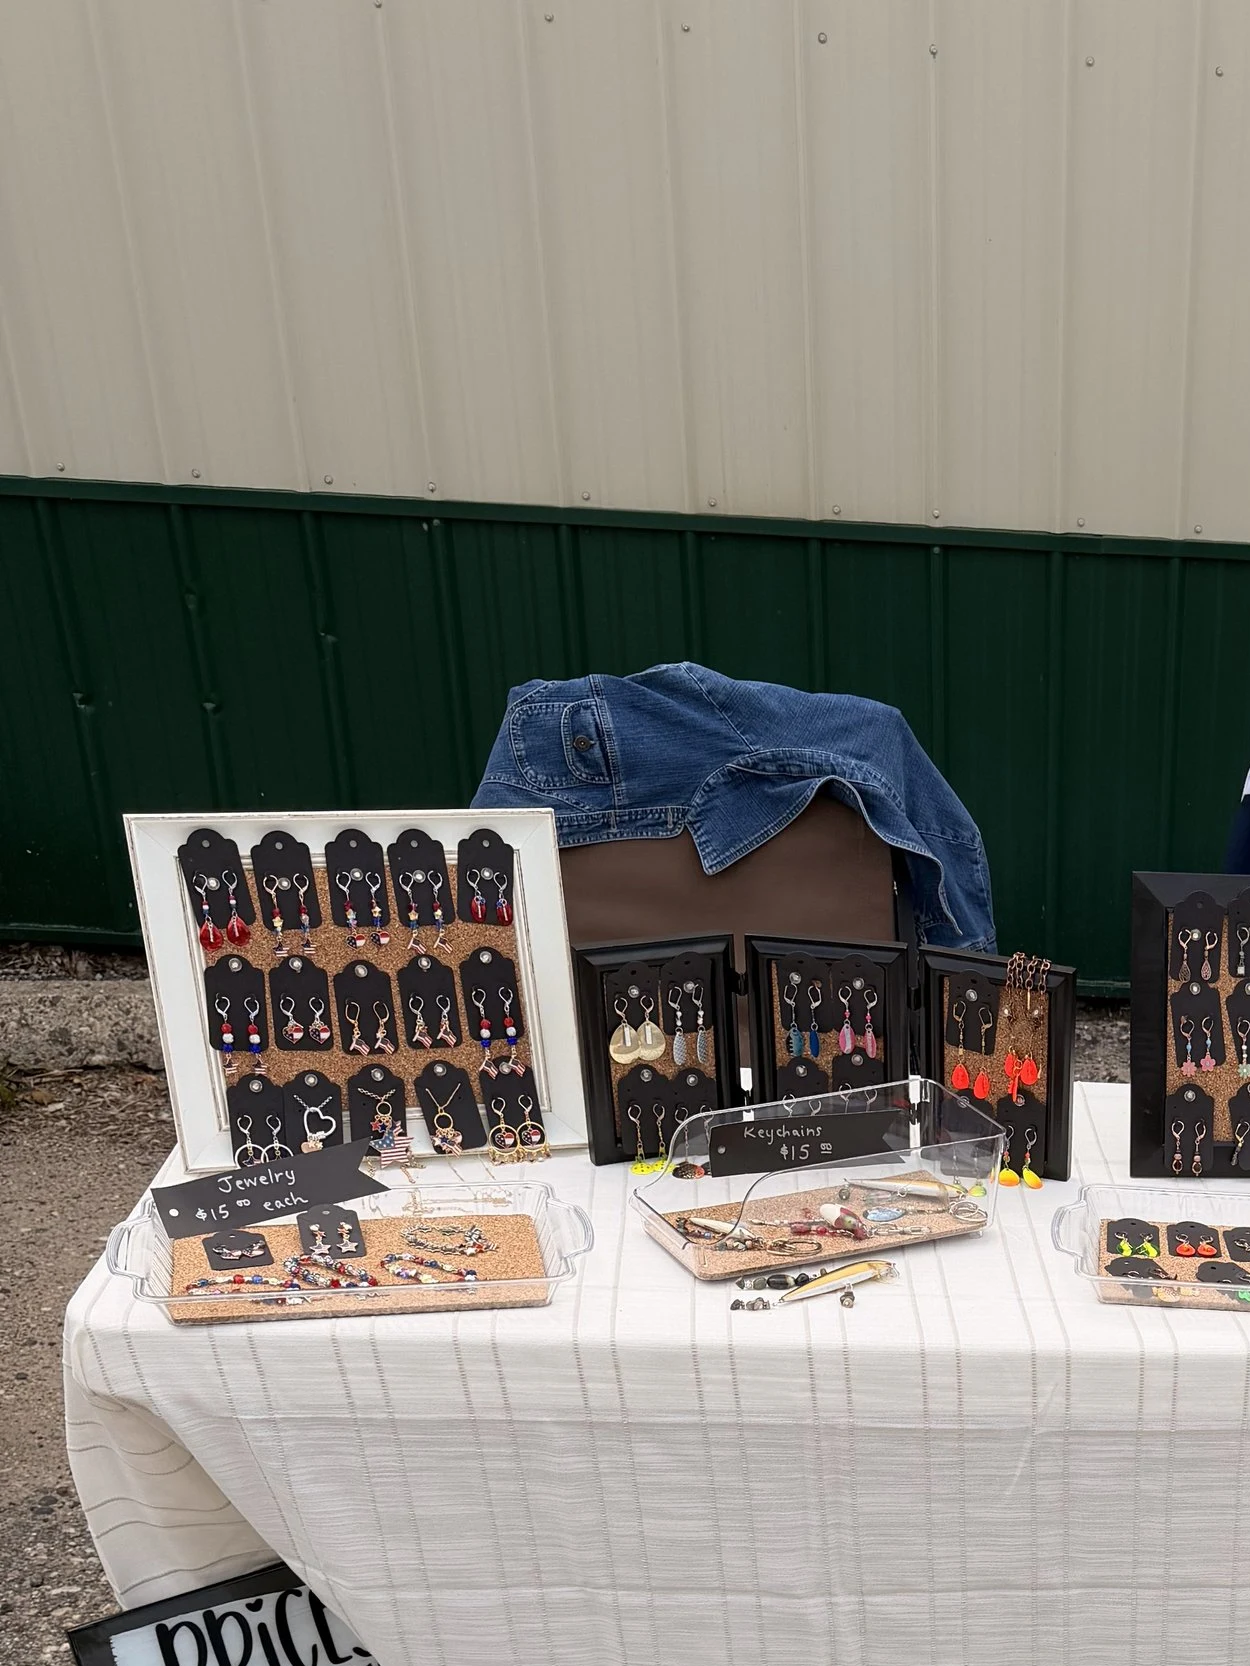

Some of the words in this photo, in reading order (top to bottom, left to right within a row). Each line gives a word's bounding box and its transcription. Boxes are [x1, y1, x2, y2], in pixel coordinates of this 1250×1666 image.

[743, 1124, 822, 1145] Keychains
[780, 1144, 810, 1160] $15
[217, 1168, 296, 1193] Jewelry
[195, 1204, 229, 1221] $15
[263, 1192, 309, 1211] each
